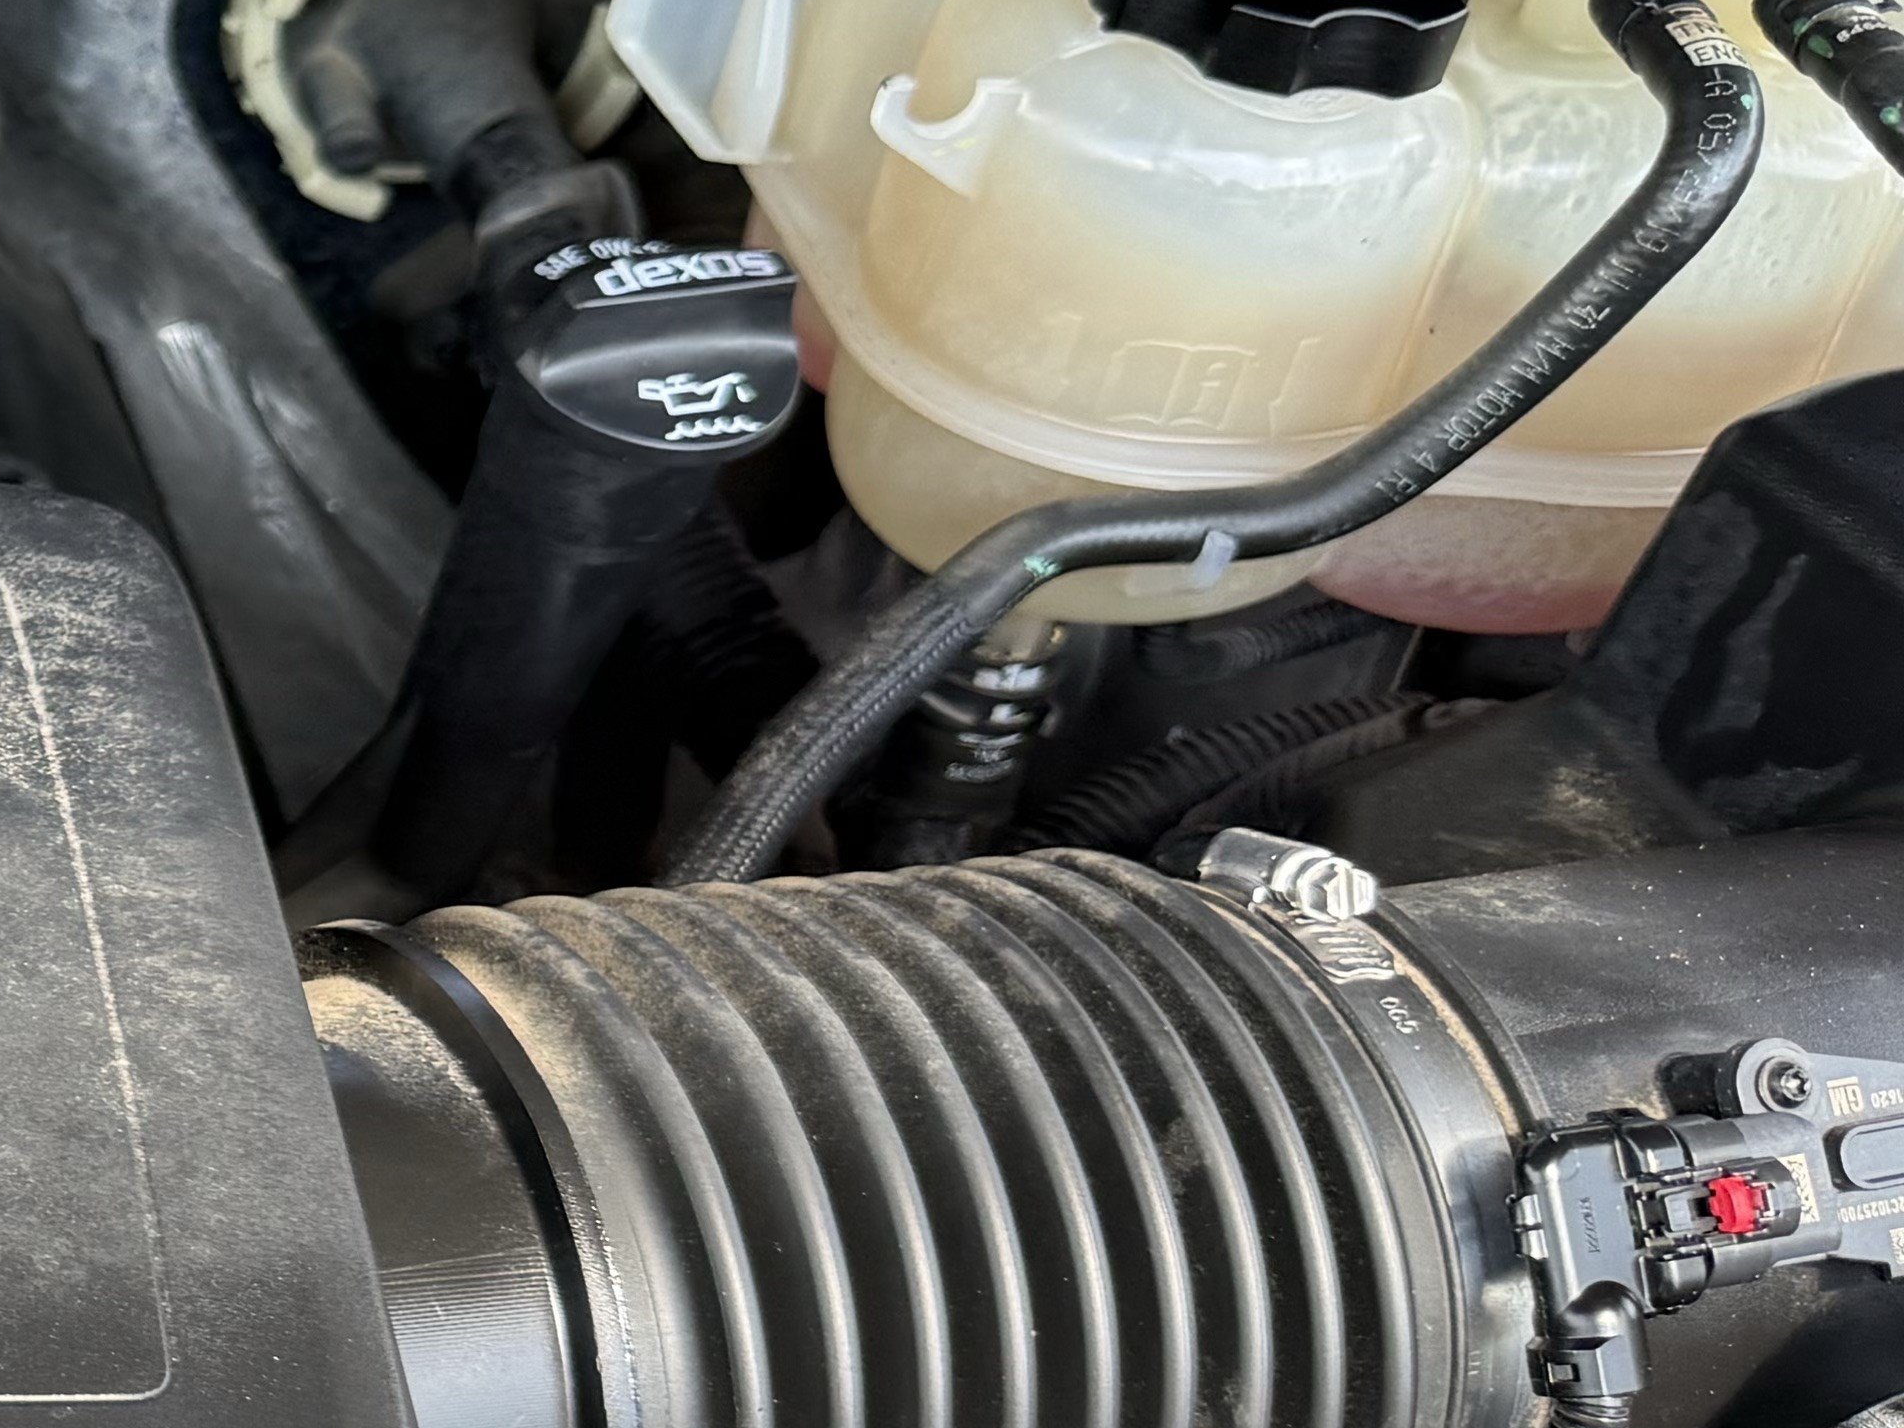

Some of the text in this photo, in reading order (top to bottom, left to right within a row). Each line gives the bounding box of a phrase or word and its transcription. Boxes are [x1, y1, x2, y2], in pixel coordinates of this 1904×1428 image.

[594, 250, 785, 296] dexos
[1433, 379, 1524, 450] MOTOR
[1827, 1083, 1863, 1117] GM
